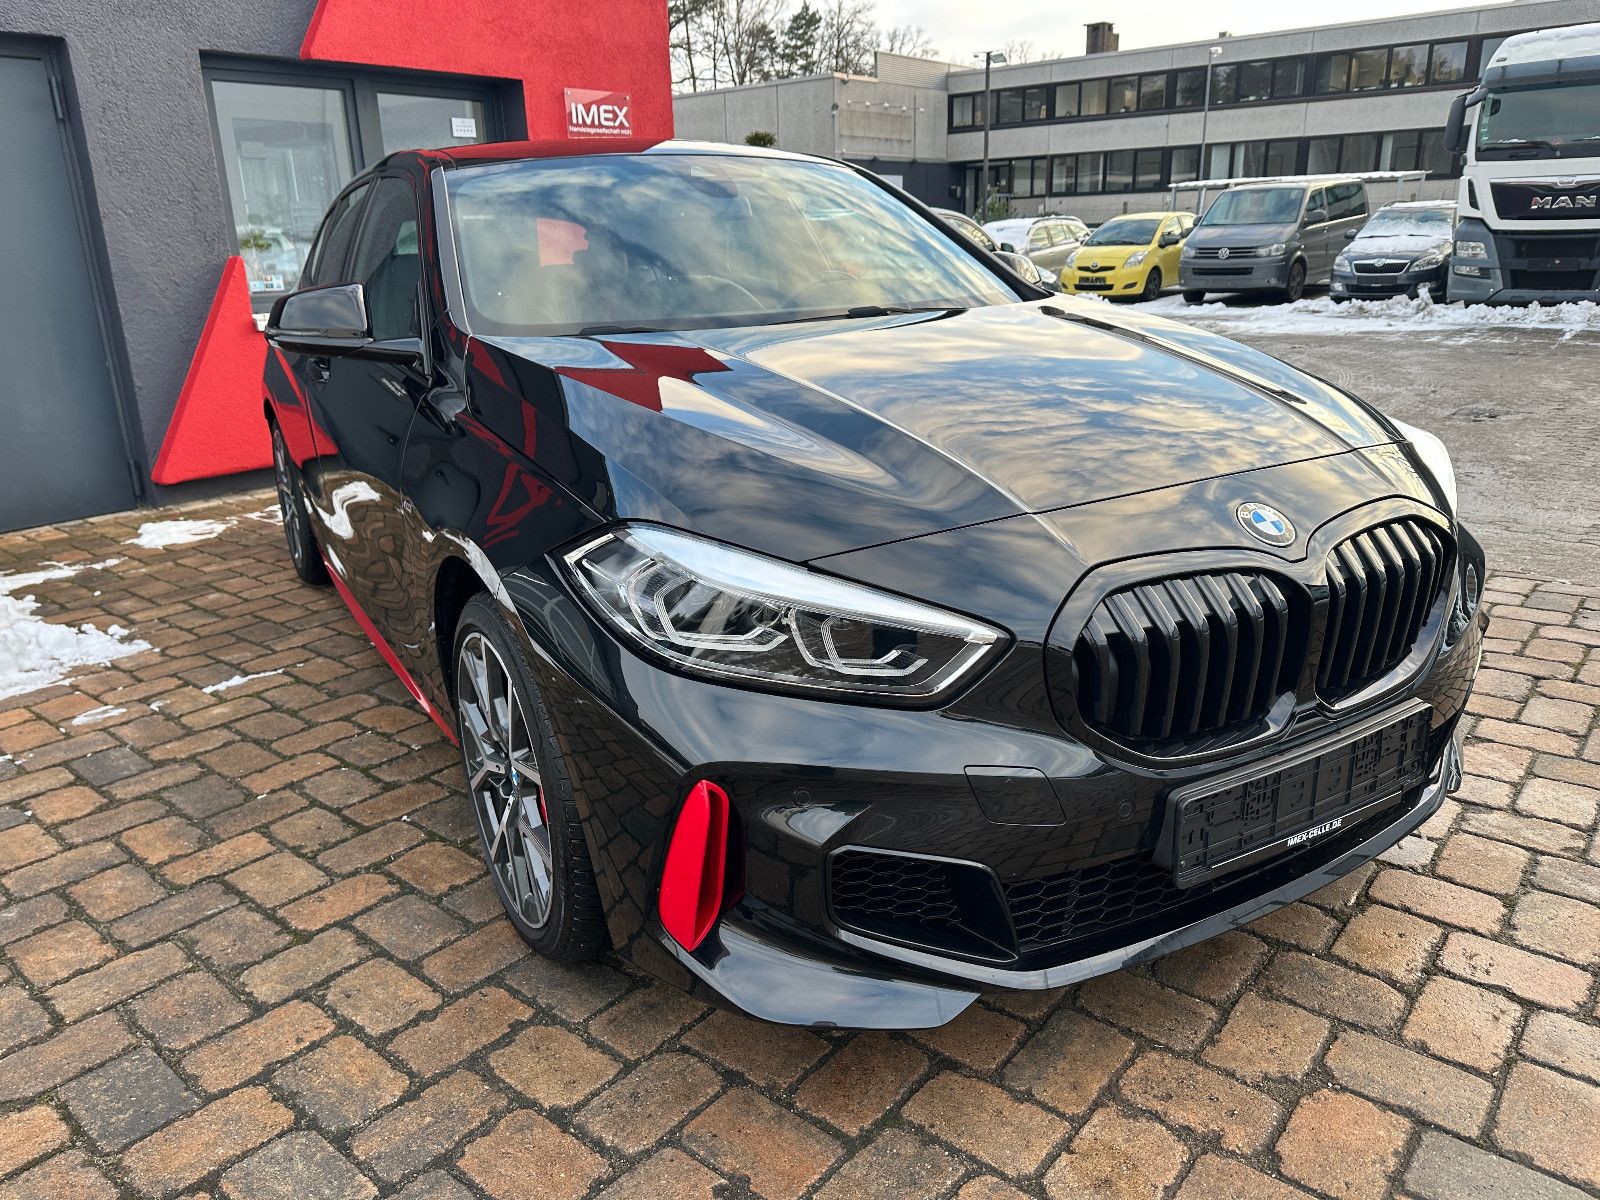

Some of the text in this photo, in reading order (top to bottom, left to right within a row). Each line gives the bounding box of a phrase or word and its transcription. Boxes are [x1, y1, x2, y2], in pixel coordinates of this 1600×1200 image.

[570, 102, 629, 127] IMEX
[1530, 195, 1597, 210] MAN
[1287, 819, 1342, 847] IMEX-CELLE.DE
